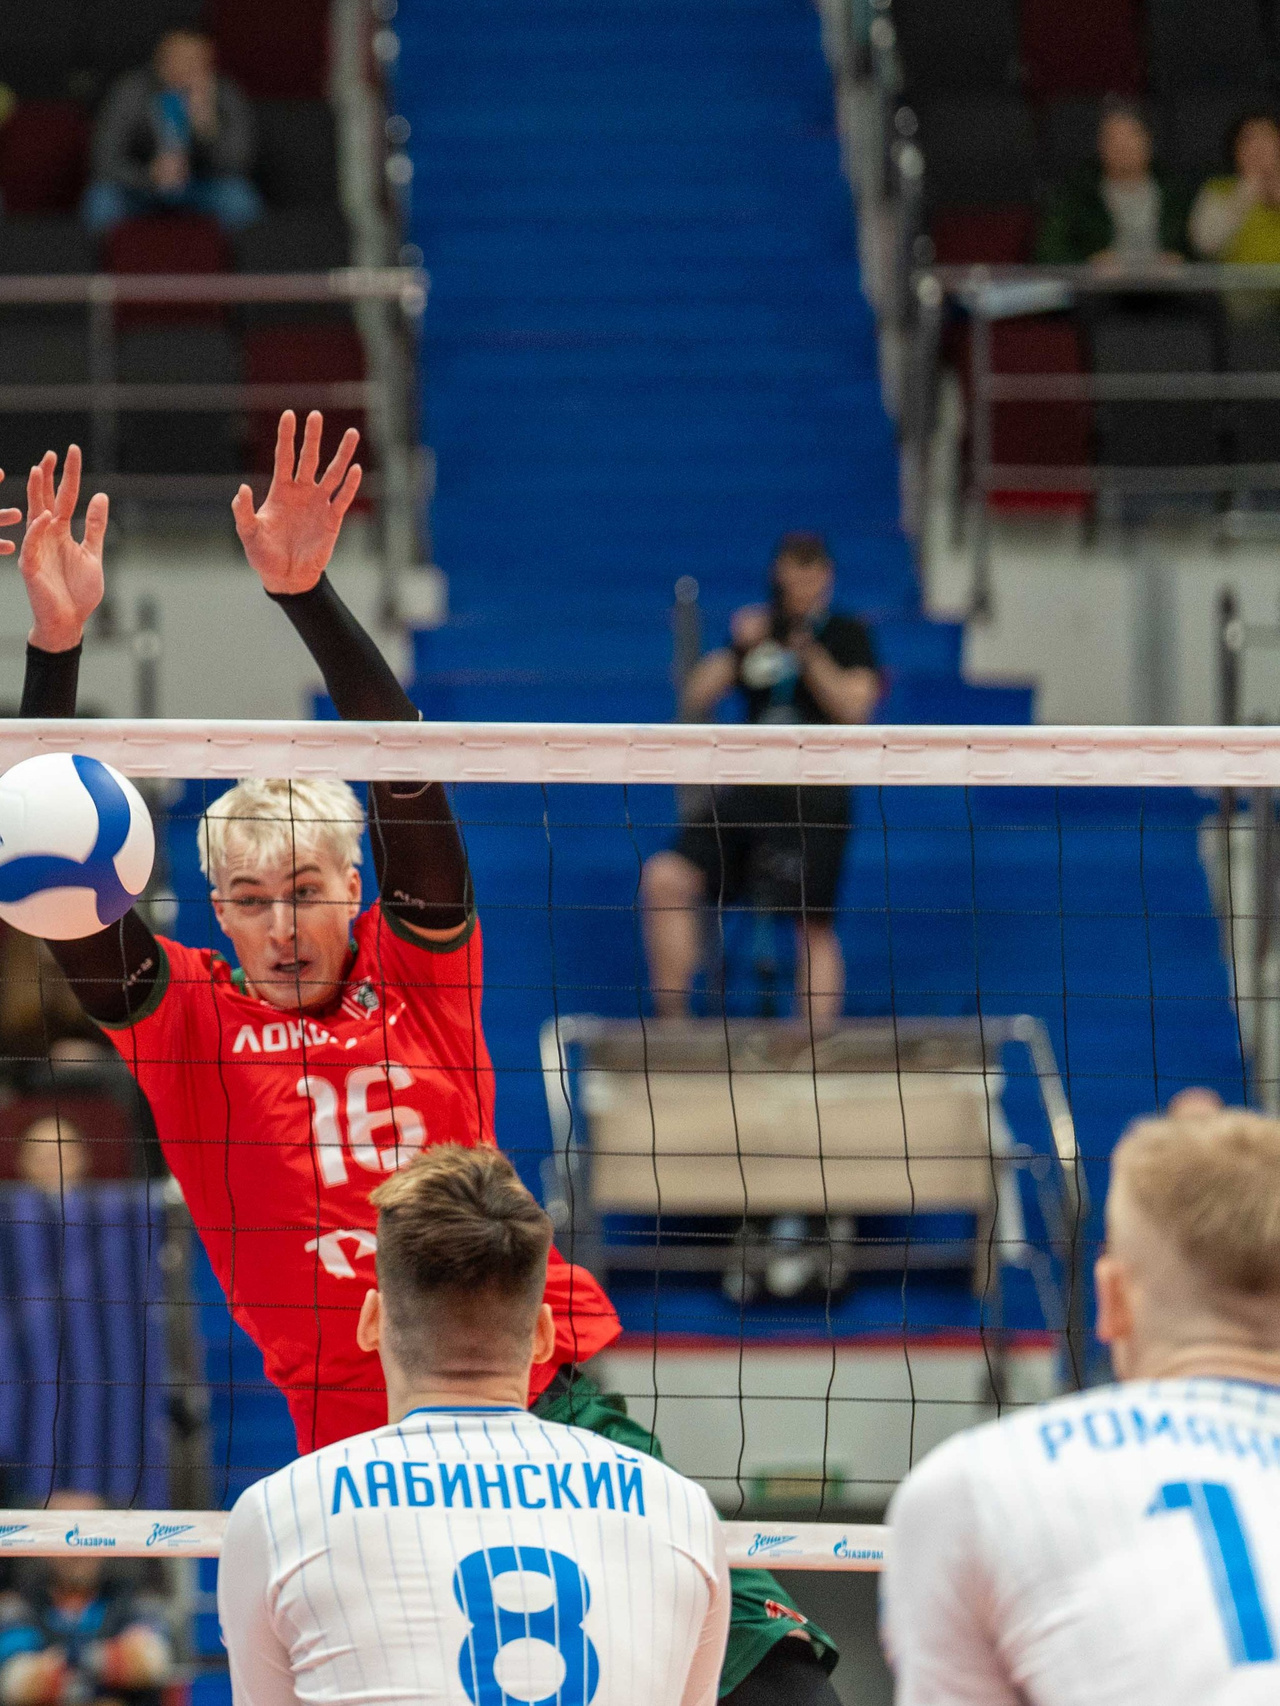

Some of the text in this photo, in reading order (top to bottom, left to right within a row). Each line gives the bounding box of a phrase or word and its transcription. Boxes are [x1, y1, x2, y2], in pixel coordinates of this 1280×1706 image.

[296, 1060, 427, 1188] 16
[331, 1453, 646, 1517] ЛАБИНСКИЙ
[1039, 1405, 1280, 1470] РОМАН
[453, 1546, 599, 1706] 8
